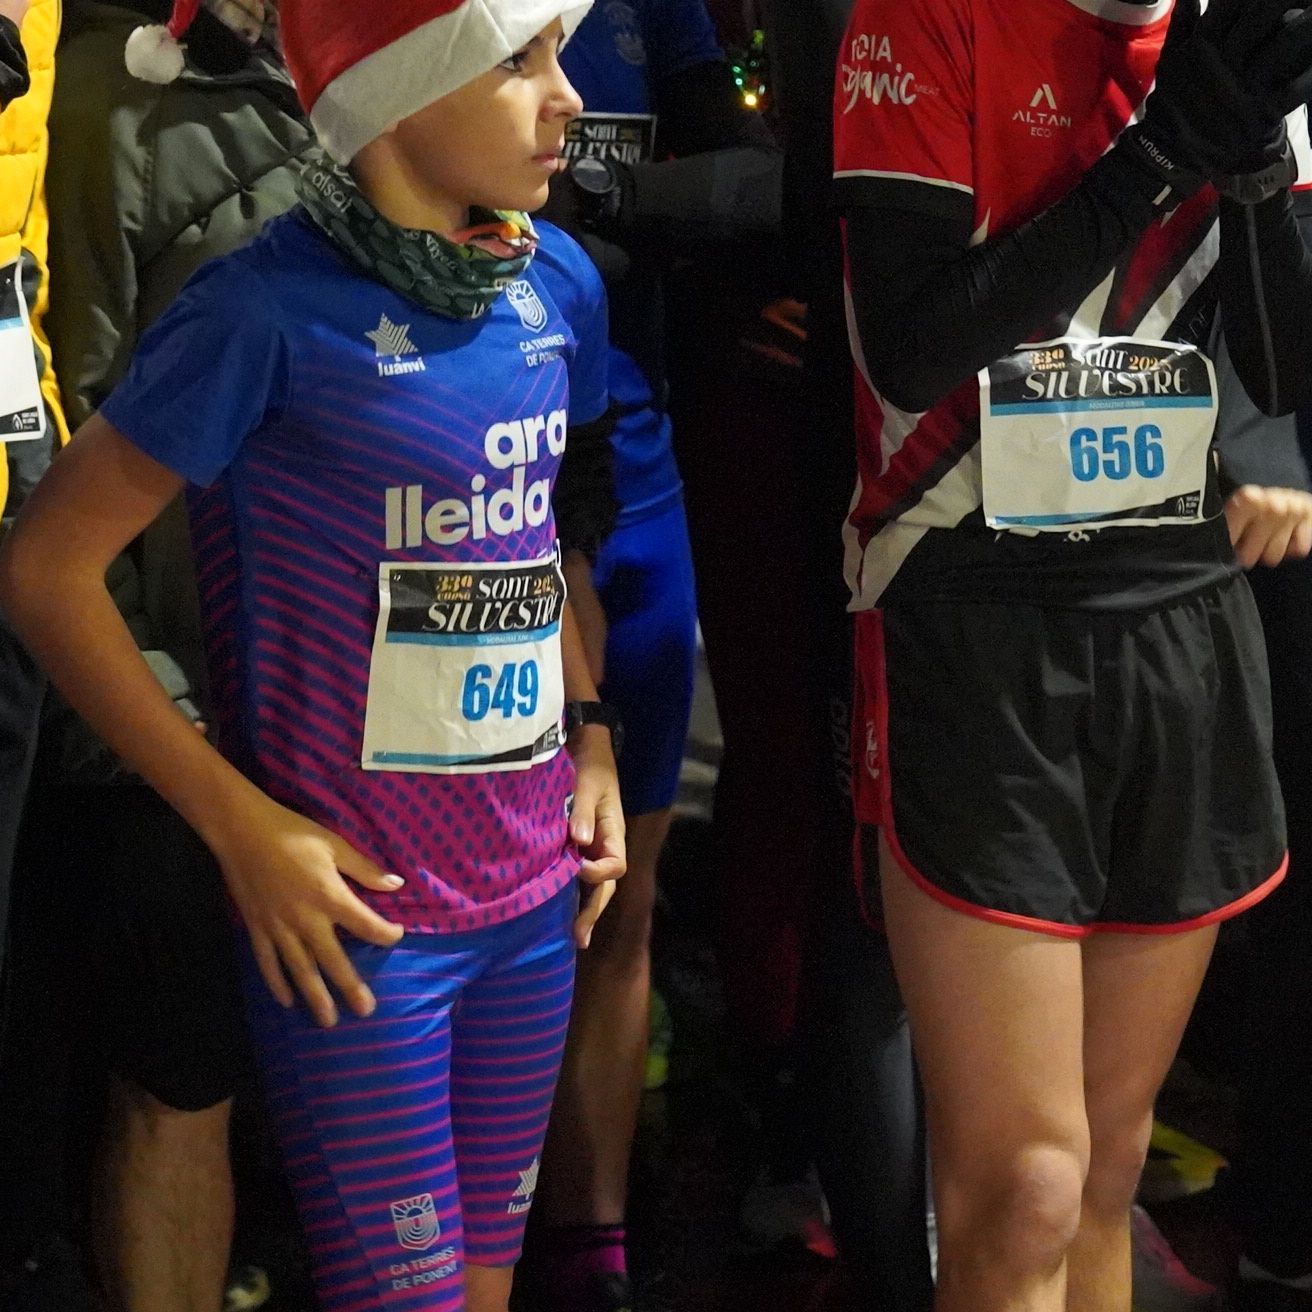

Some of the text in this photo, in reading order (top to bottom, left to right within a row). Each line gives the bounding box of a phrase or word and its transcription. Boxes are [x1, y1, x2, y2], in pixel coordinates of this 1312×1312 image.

[1011, 109, 1073, 128] ALTAN
[1139, 135, 1175, 170] KIPRUN
[484, 408, 567, 470] ara
[1069, 423, 1166, 482] 656
[385, 465, 550, 550] lleida
[461, 659, 539, 722] 649
[391, 1277, 411, 1291] DE
